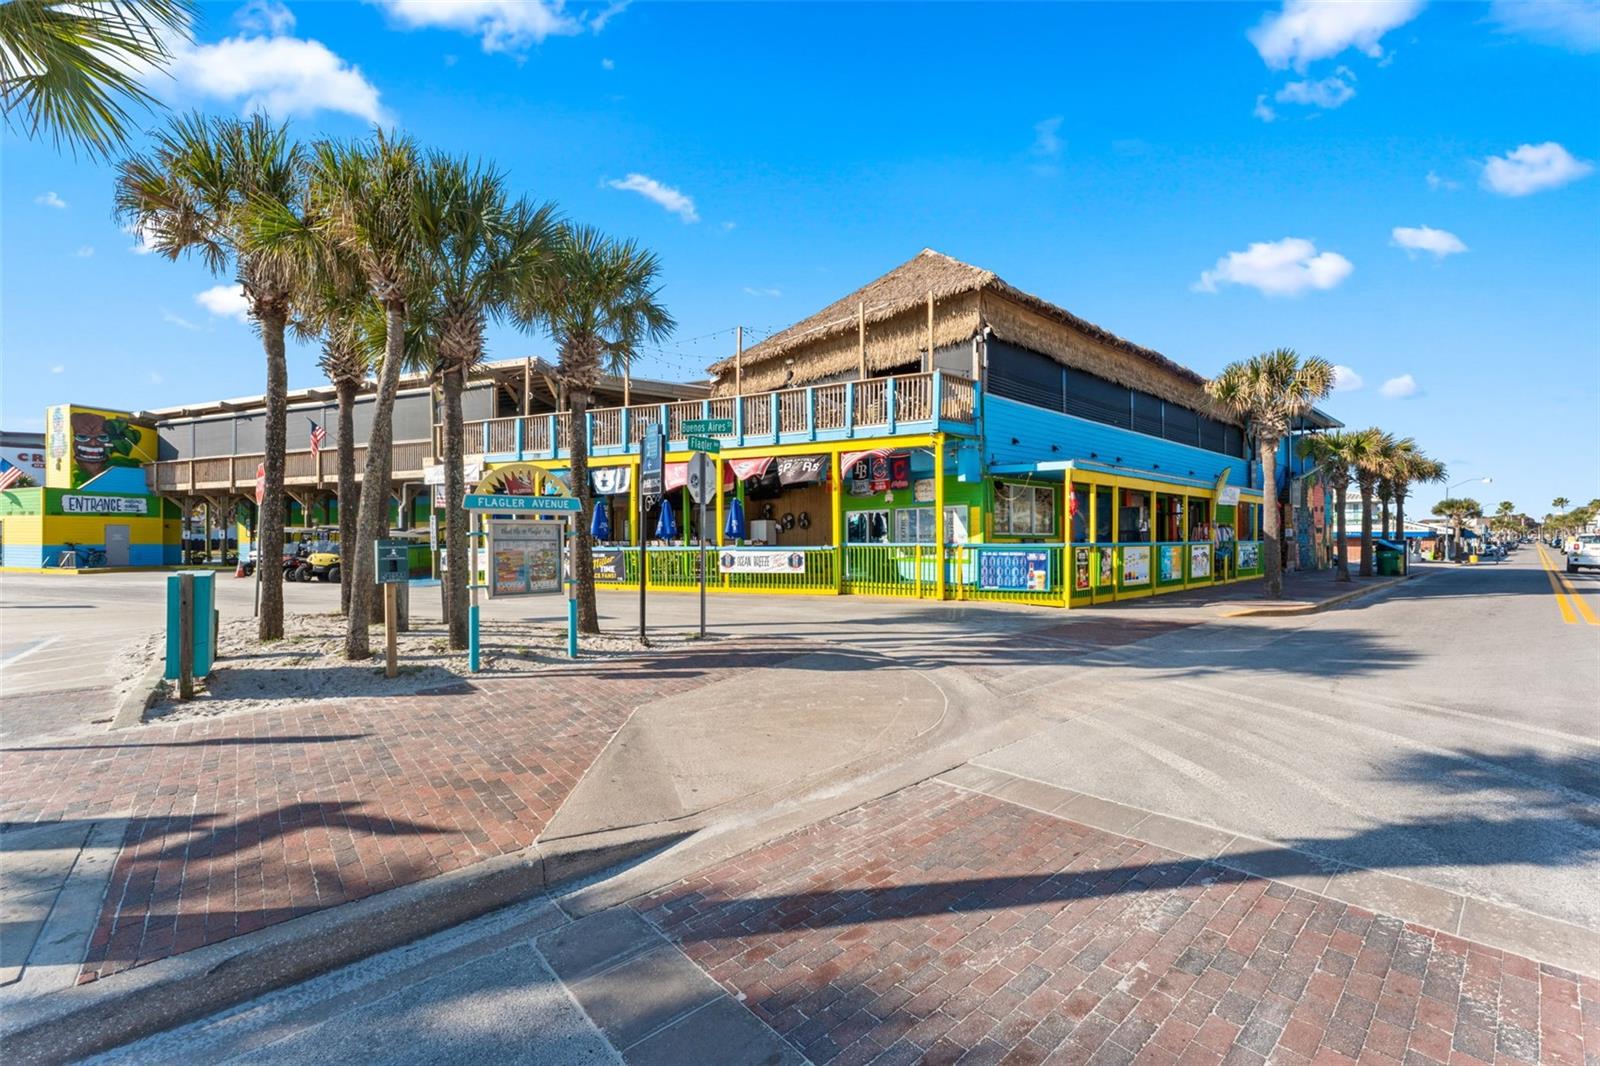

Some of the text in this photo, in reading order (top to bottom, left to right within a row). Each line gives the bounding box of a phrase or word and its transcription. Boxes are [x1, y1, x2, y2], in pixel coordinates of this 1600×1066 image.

[682, 423, 705, 433] Buenos
[707, 422, 726, 432] Aires
[691, 437, 713, 451] Flagler
[68, 496, 122, 512] ENTRANCE
[477, 497, 569, 509] FLAGLER AVENUE
[600, 565, 616, 573] TIME
